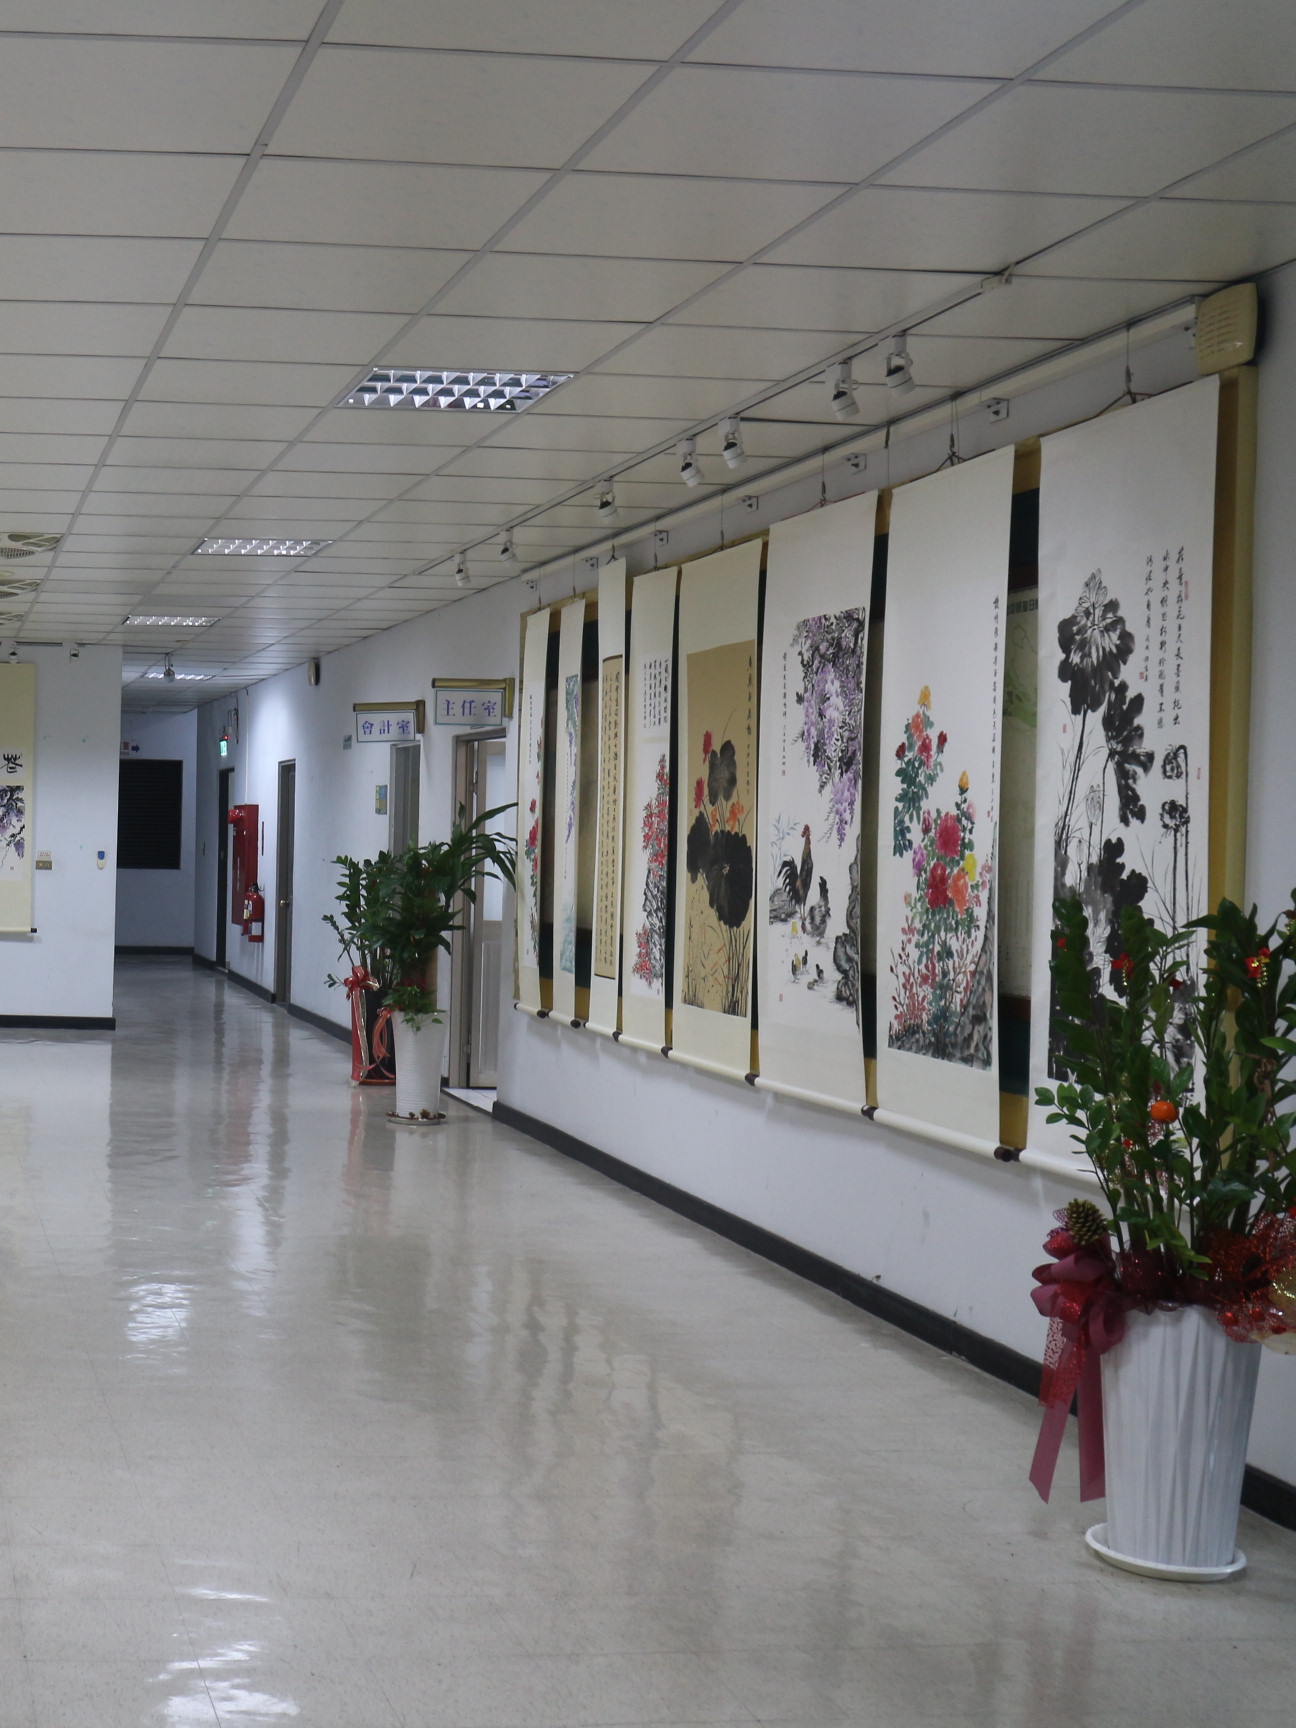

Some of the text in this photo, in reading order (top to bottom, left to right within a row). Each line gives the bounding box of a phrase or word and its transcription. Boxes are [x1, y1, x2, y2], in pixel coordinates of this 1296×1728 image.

[442, 699, 497, 717] 主任室
[361, 720, 411, 735] 會計室
